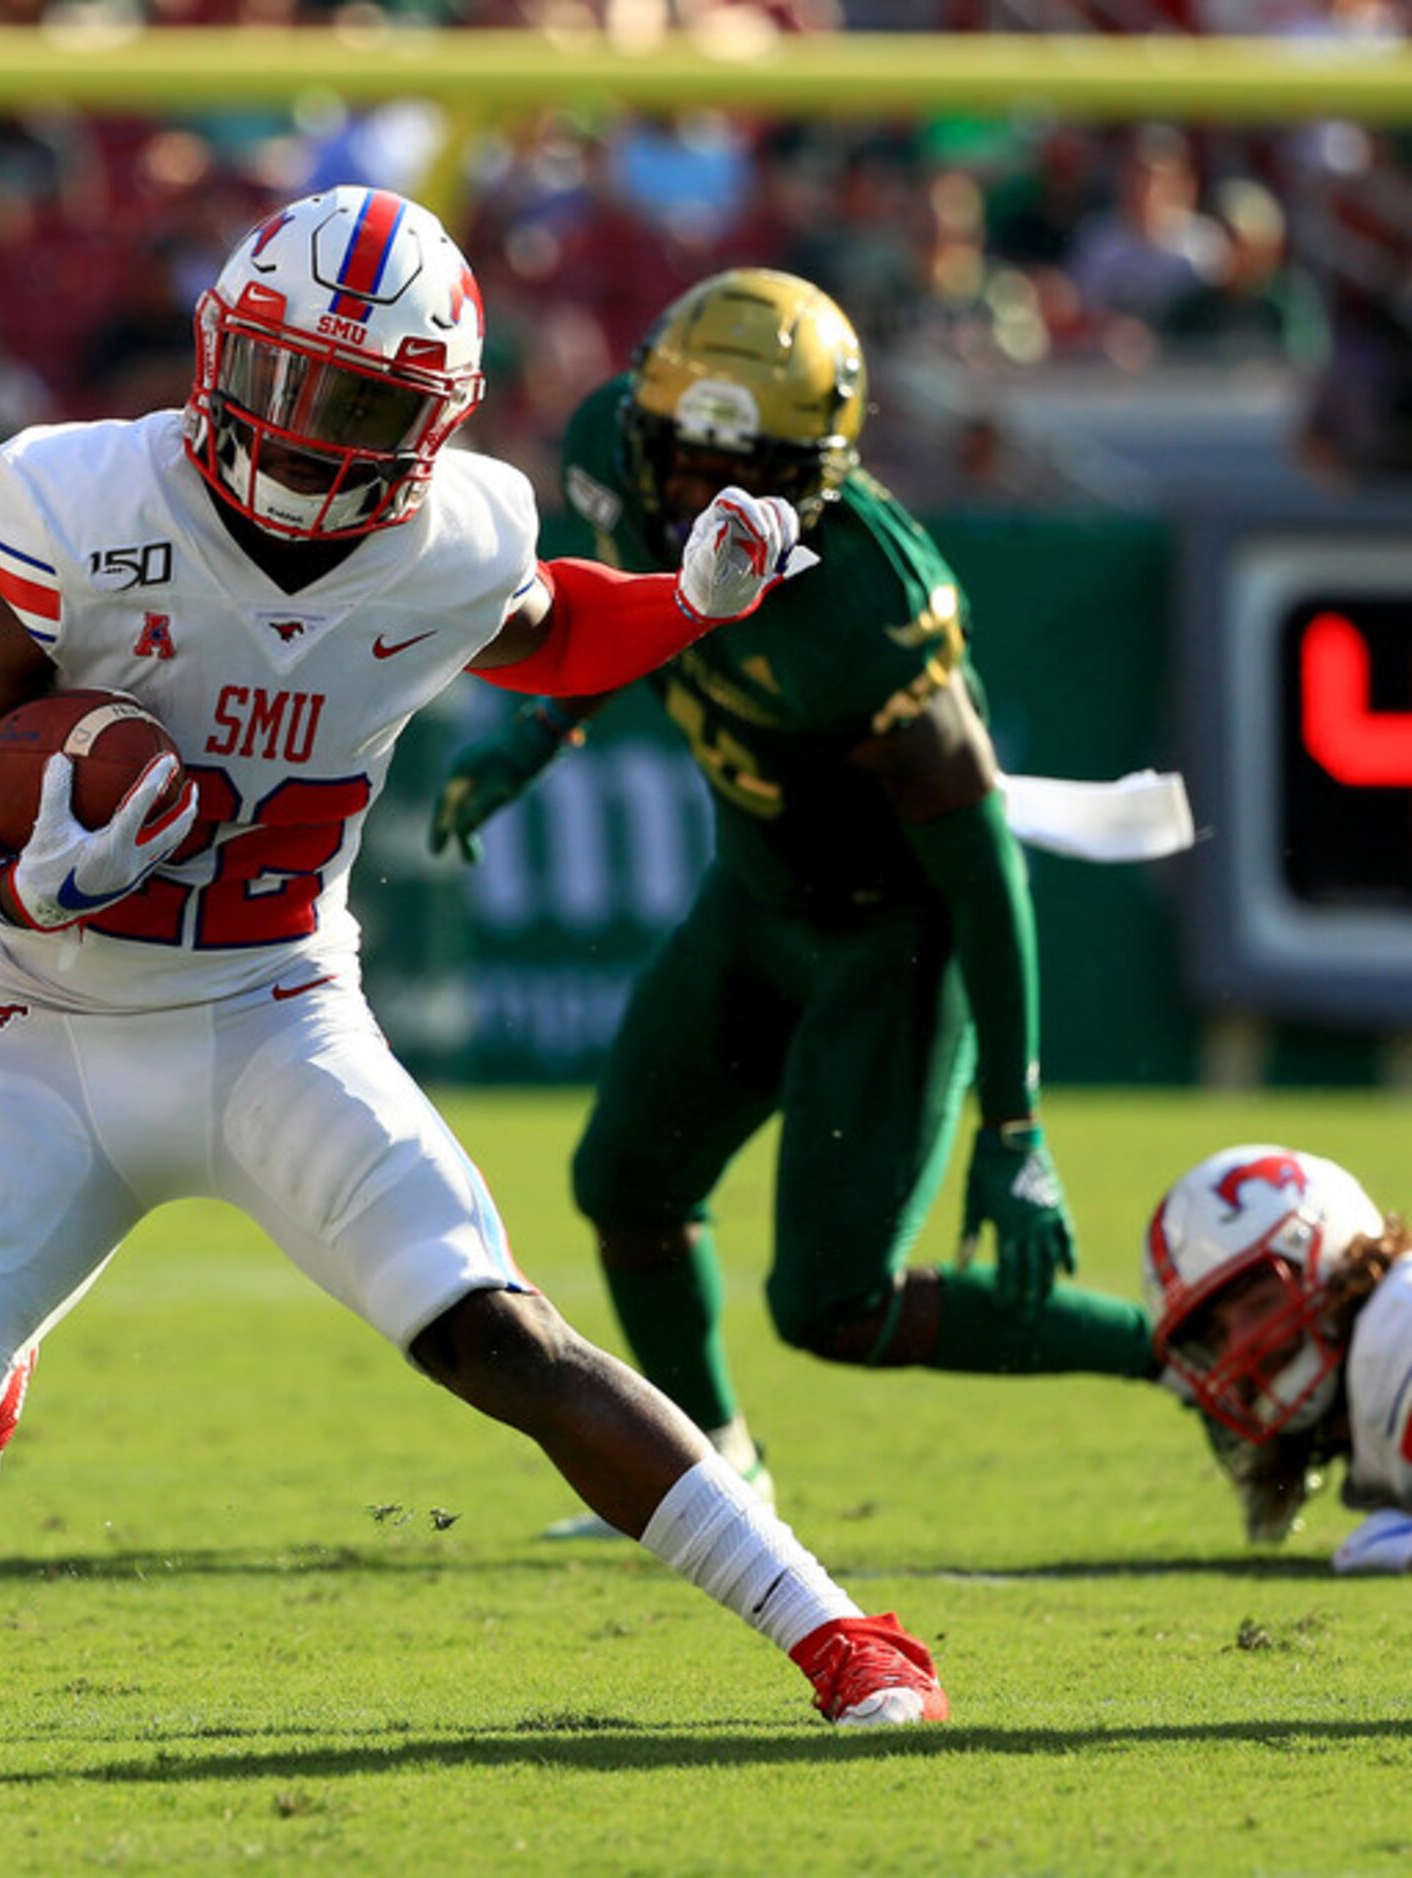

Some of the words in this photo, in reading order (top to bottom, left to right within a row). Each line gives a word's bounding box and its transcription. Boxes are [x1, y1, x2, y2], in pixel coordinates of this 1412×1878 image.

[316, 314, 368, 346] SMU
[90, 541, 173, 593] 150
[133, 610, 177, 661] A
[204, 684, 326, 764] SMU
